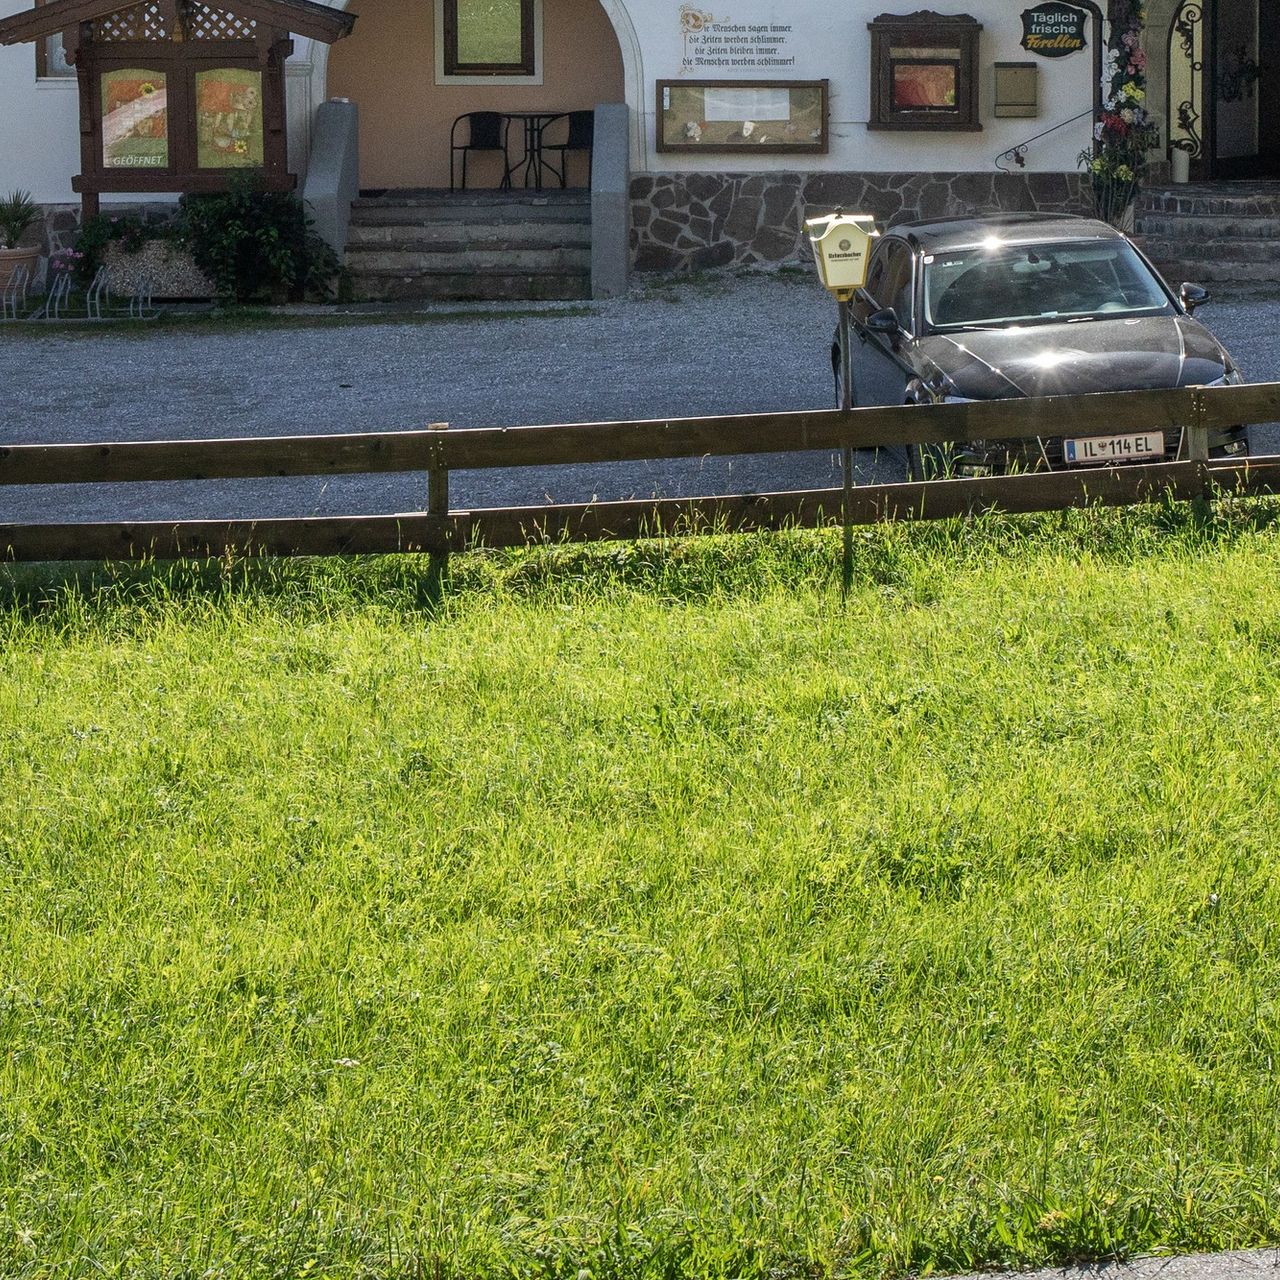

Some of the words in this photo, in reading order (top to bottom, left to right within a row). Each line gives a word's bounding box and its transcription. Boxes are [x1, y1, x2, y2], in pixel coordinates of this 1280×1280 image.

[1031, 13, 1077, 25] Täglich
[712, 24, 746, 33] Menschen
[748, 25, 768, 34] sagen
[1031, 24, 1077, 34] frische
[689, 35, 700, 44] die
[701, 35, 721, 45] Zeiten
[724, 35, 749, 44] werden
[1026, 34, 1081, 49] Forellen
[694, 46, 705, 55] die
[707, 46, 728, 55] Zeiten
[729, 46, 754, 55] bleiben
[682, 57, 693, 66] die
[695, 57, 729, 66] Menschen
[731, 57, 755, 66] werden
[114, 155, 163, 166] GEÖFFNET
[1083, 441, 1098, 458] IL
[1108, 438, 1132, 455] 114
[1135, 436, 1153, 453] EL
